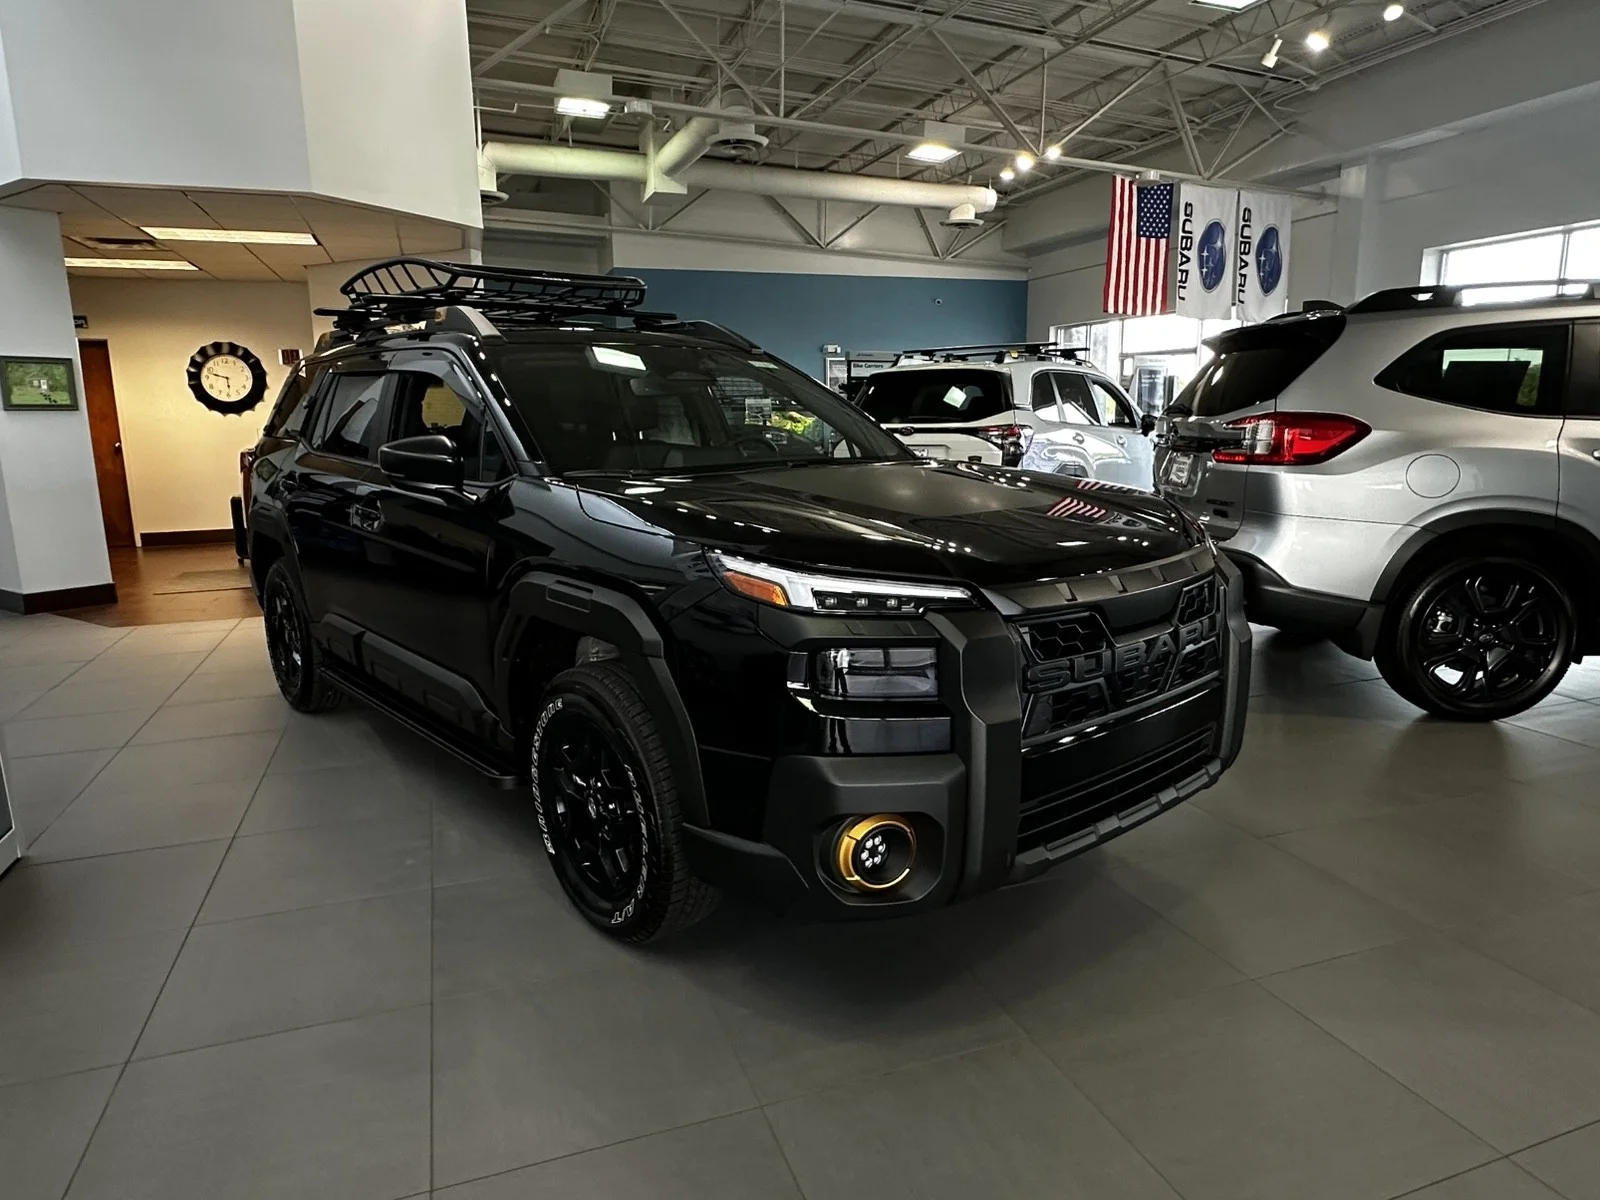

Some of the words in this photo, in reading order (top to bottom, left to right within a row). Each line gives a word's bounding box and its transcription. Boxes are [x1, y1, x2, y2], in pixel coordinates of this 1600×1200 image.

[1177, 201, 1194, 301] SUBARU
[1237, 207, 1252, 304] SUBARU
[1027, 611, 1222, 693] SUBARU
[531, 698, 563, 856] BRIDGESTONE
[611, 898, 635, 925] A/T
